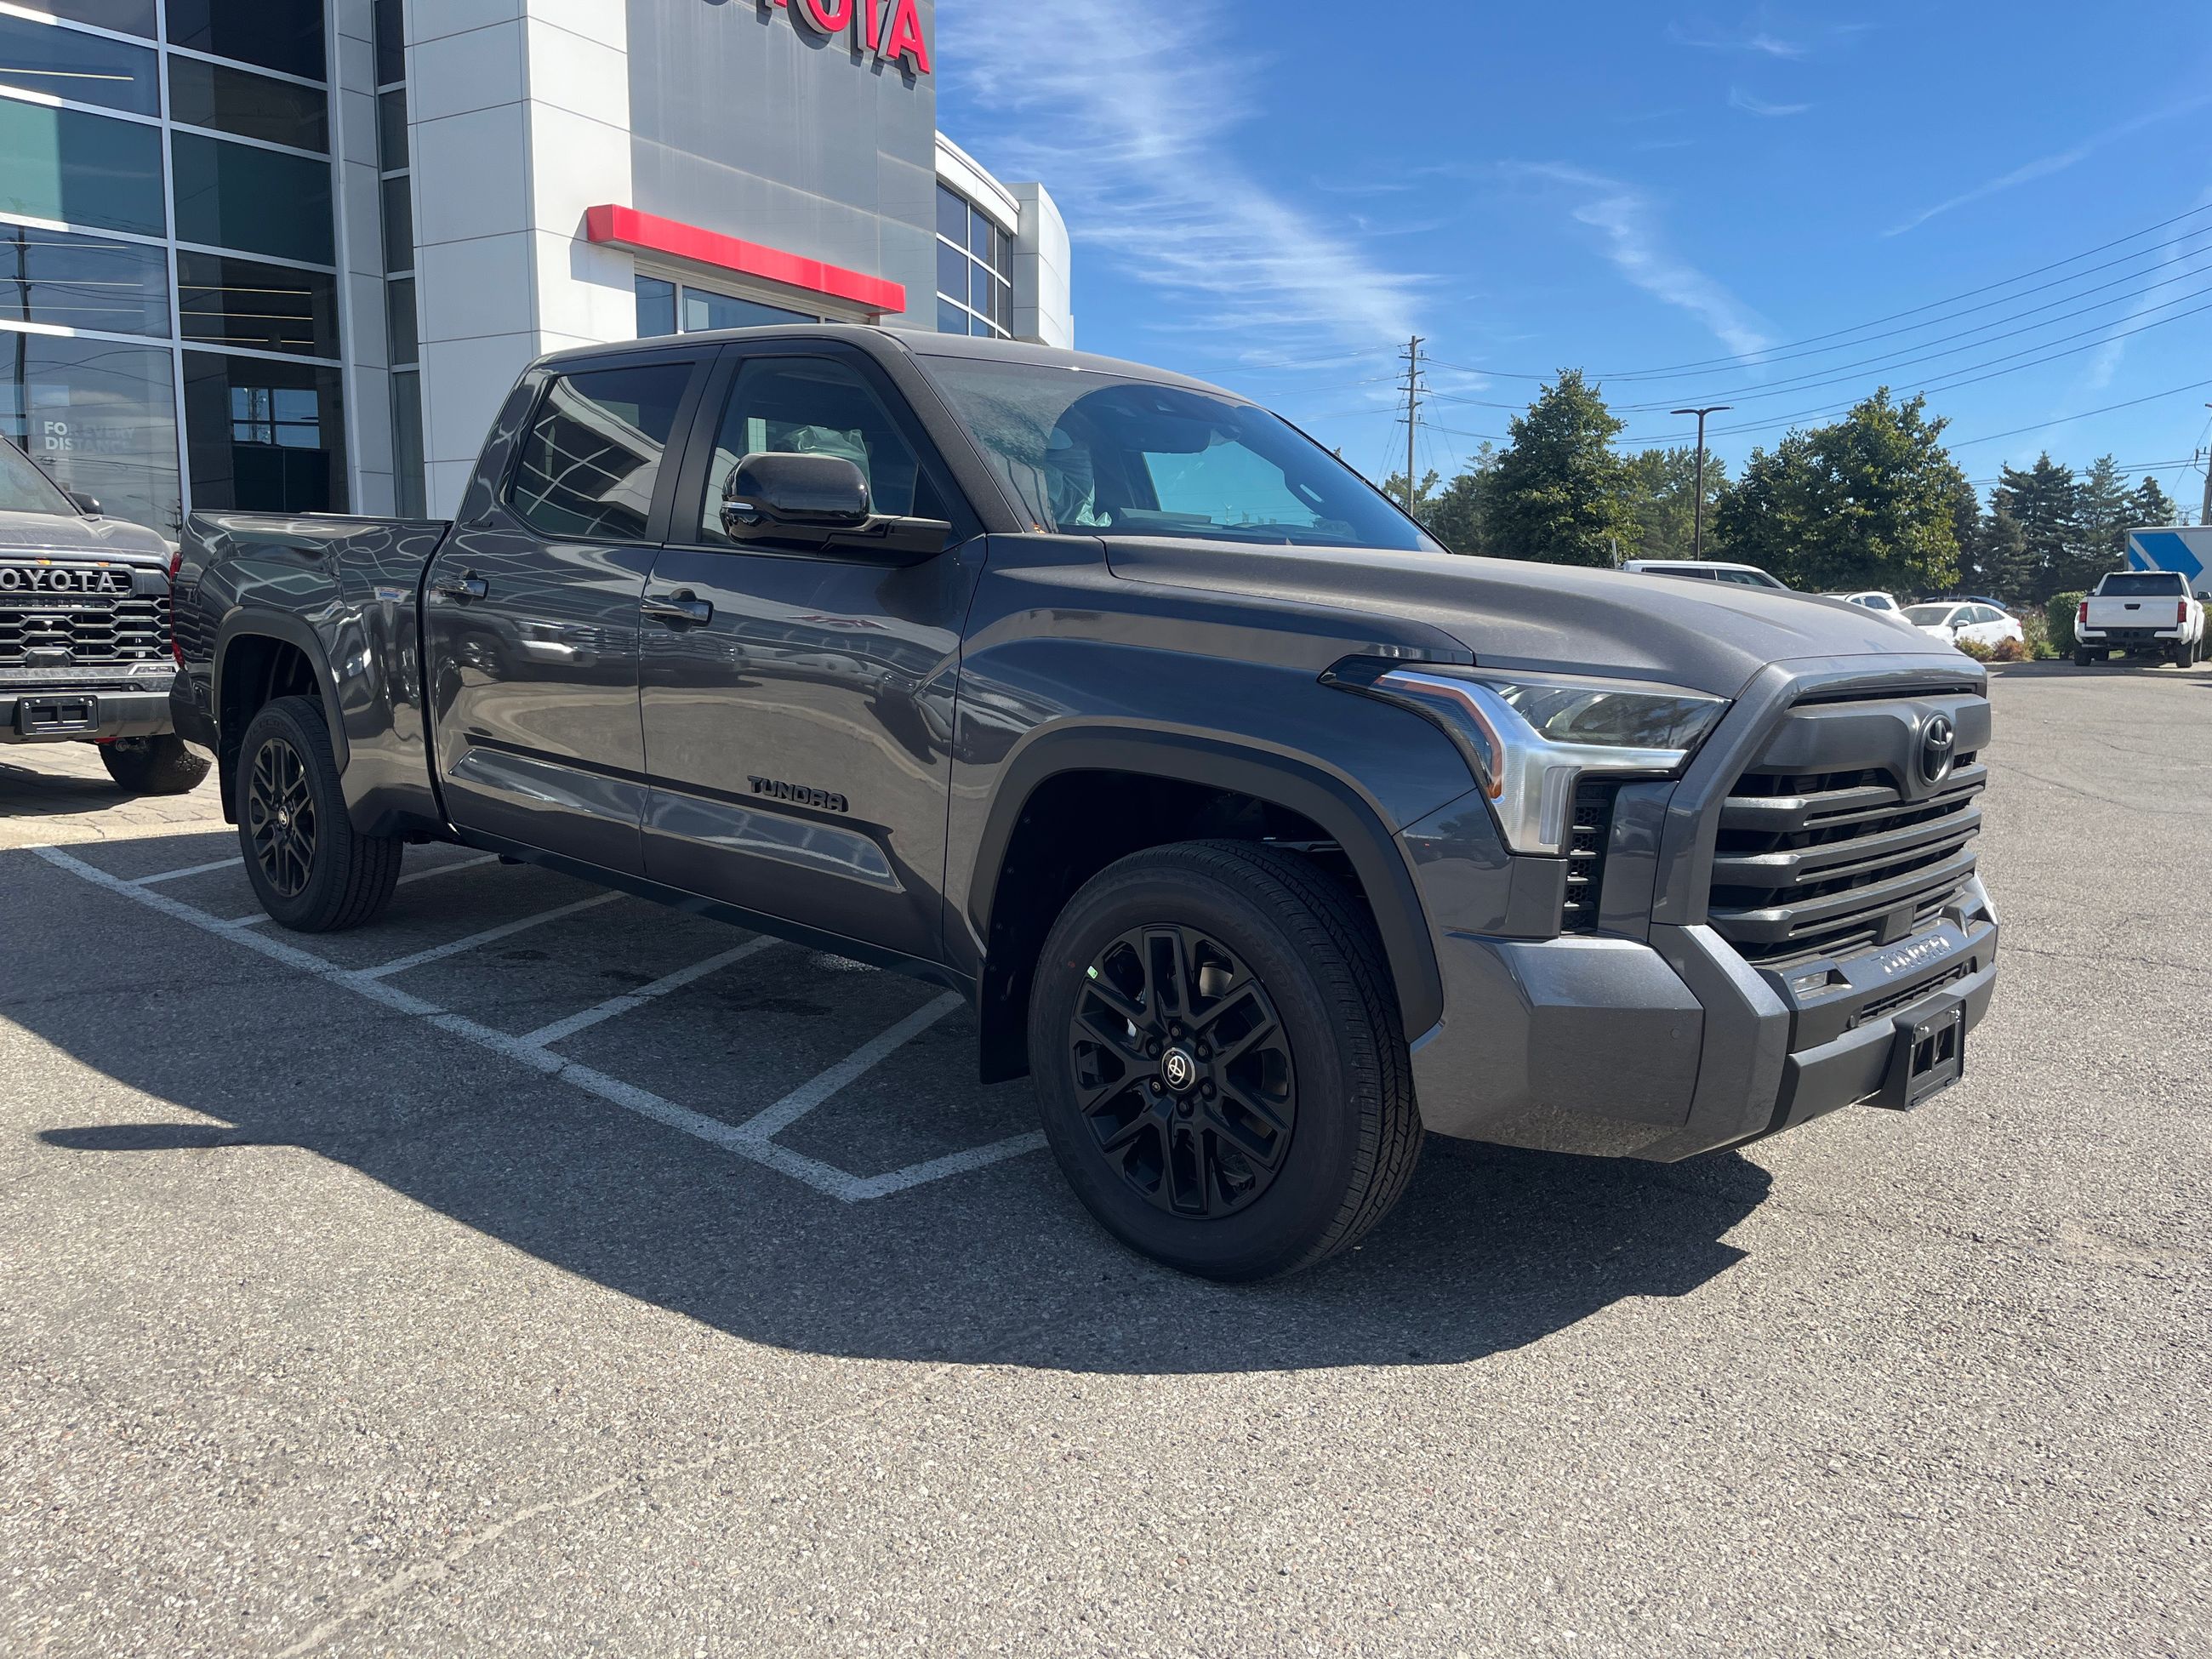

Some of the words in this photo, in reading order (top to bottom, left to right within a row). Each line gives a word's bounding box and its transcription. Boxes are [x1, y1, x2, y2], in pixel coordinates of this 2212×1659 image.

[765, 0, 931, 75] OTA
[747, 775, 849, 812] TUNDRA
[1870, 934, 1953, 976] TUNDRA
